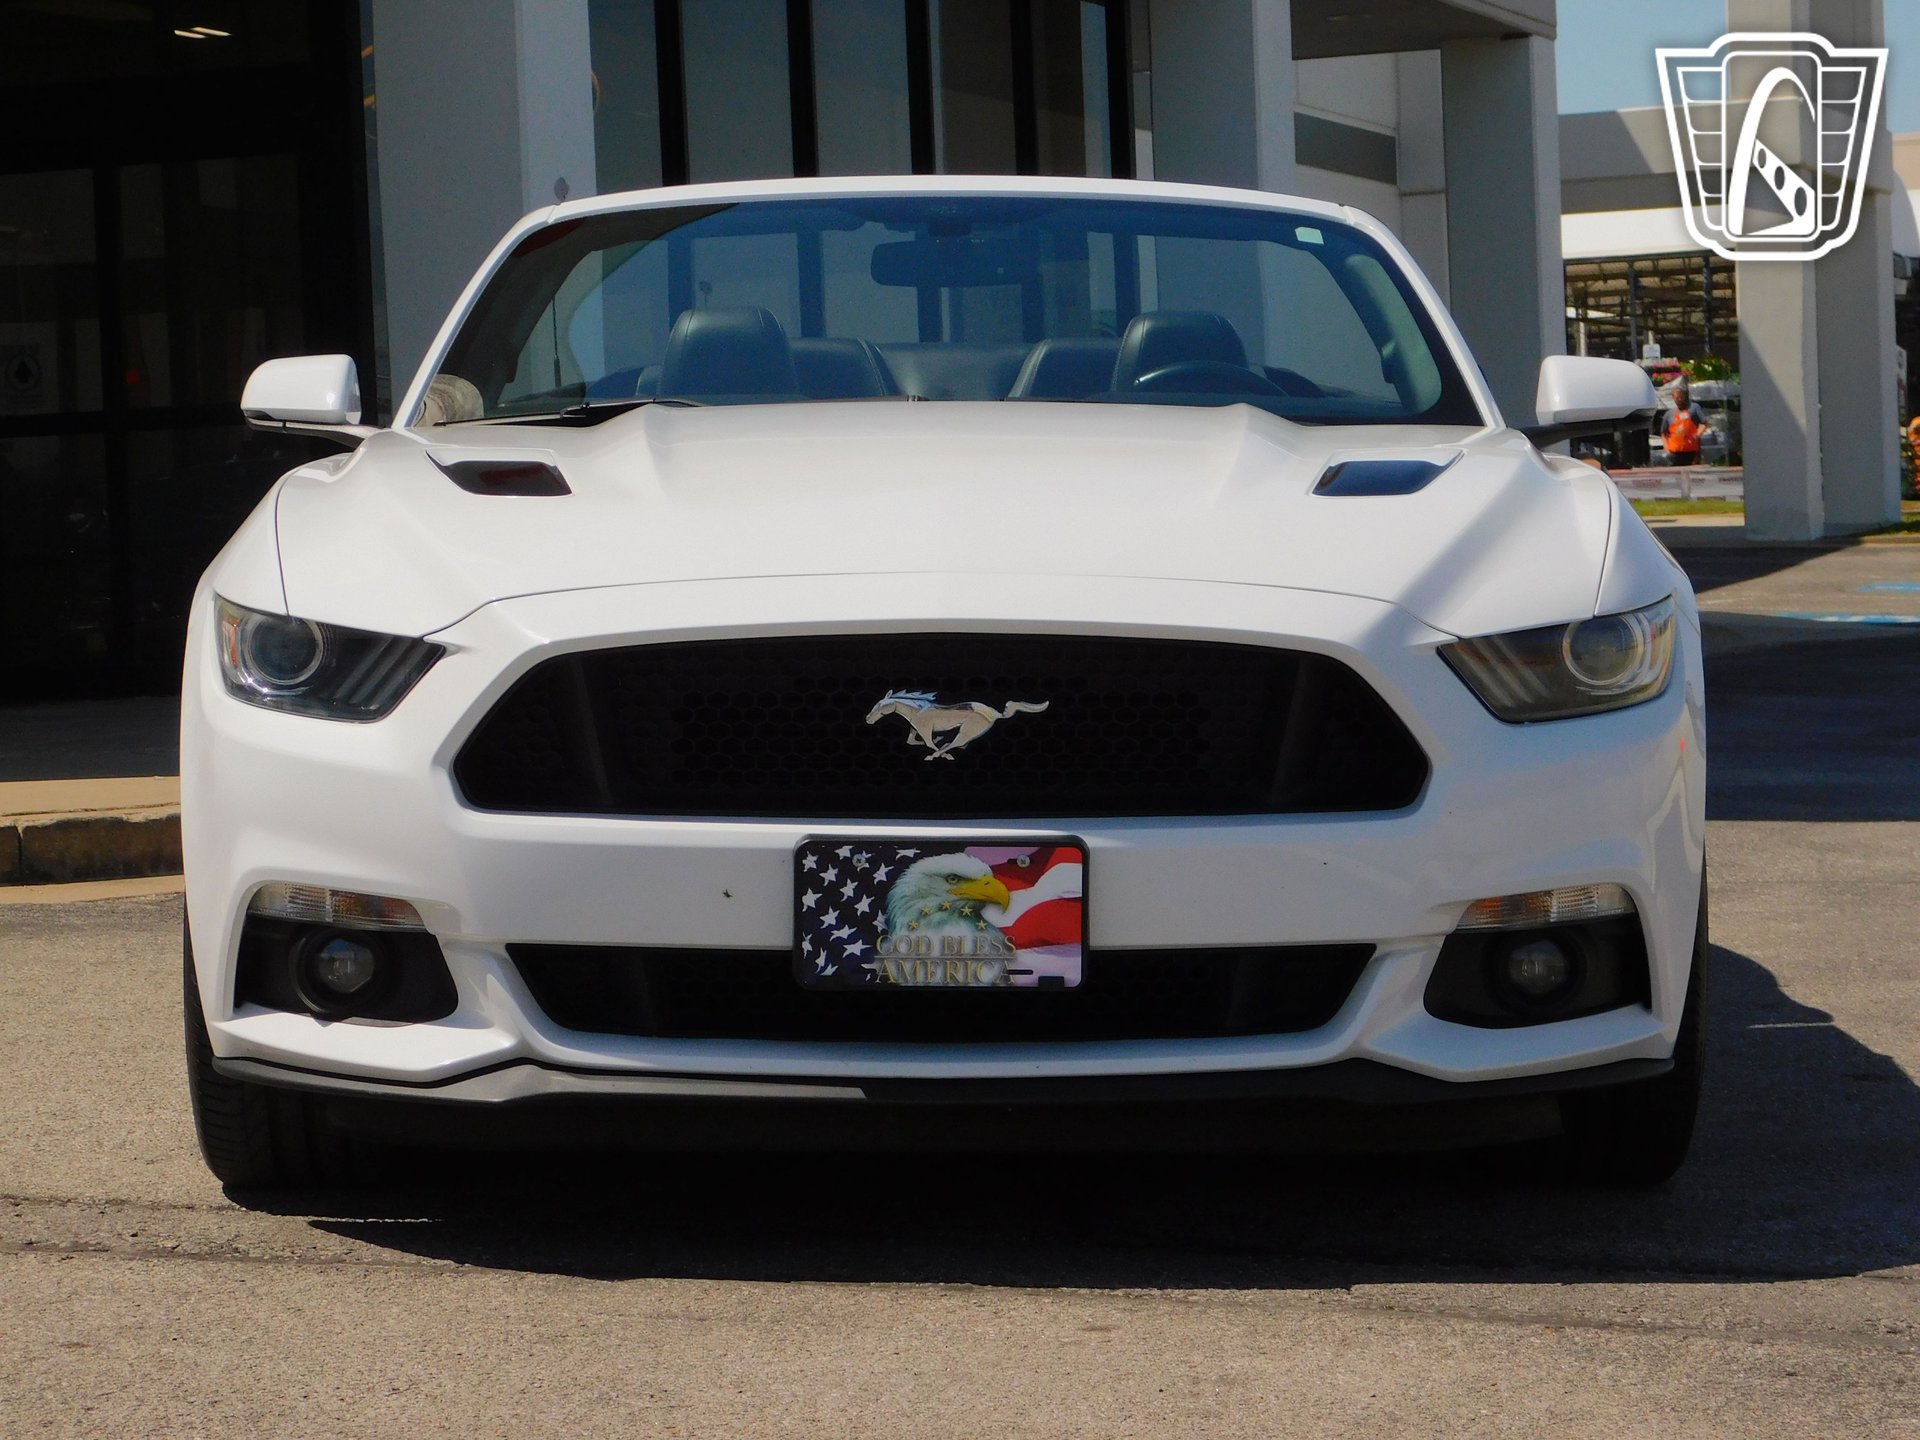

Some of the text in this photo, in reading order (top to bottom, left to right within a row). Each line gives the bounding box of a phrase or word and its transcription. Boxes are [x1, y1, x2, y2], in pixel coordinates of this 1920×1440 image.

[876, 934, 1017, 955] GOD BLESS
[875, 959, 1016, 984] AMERICA
